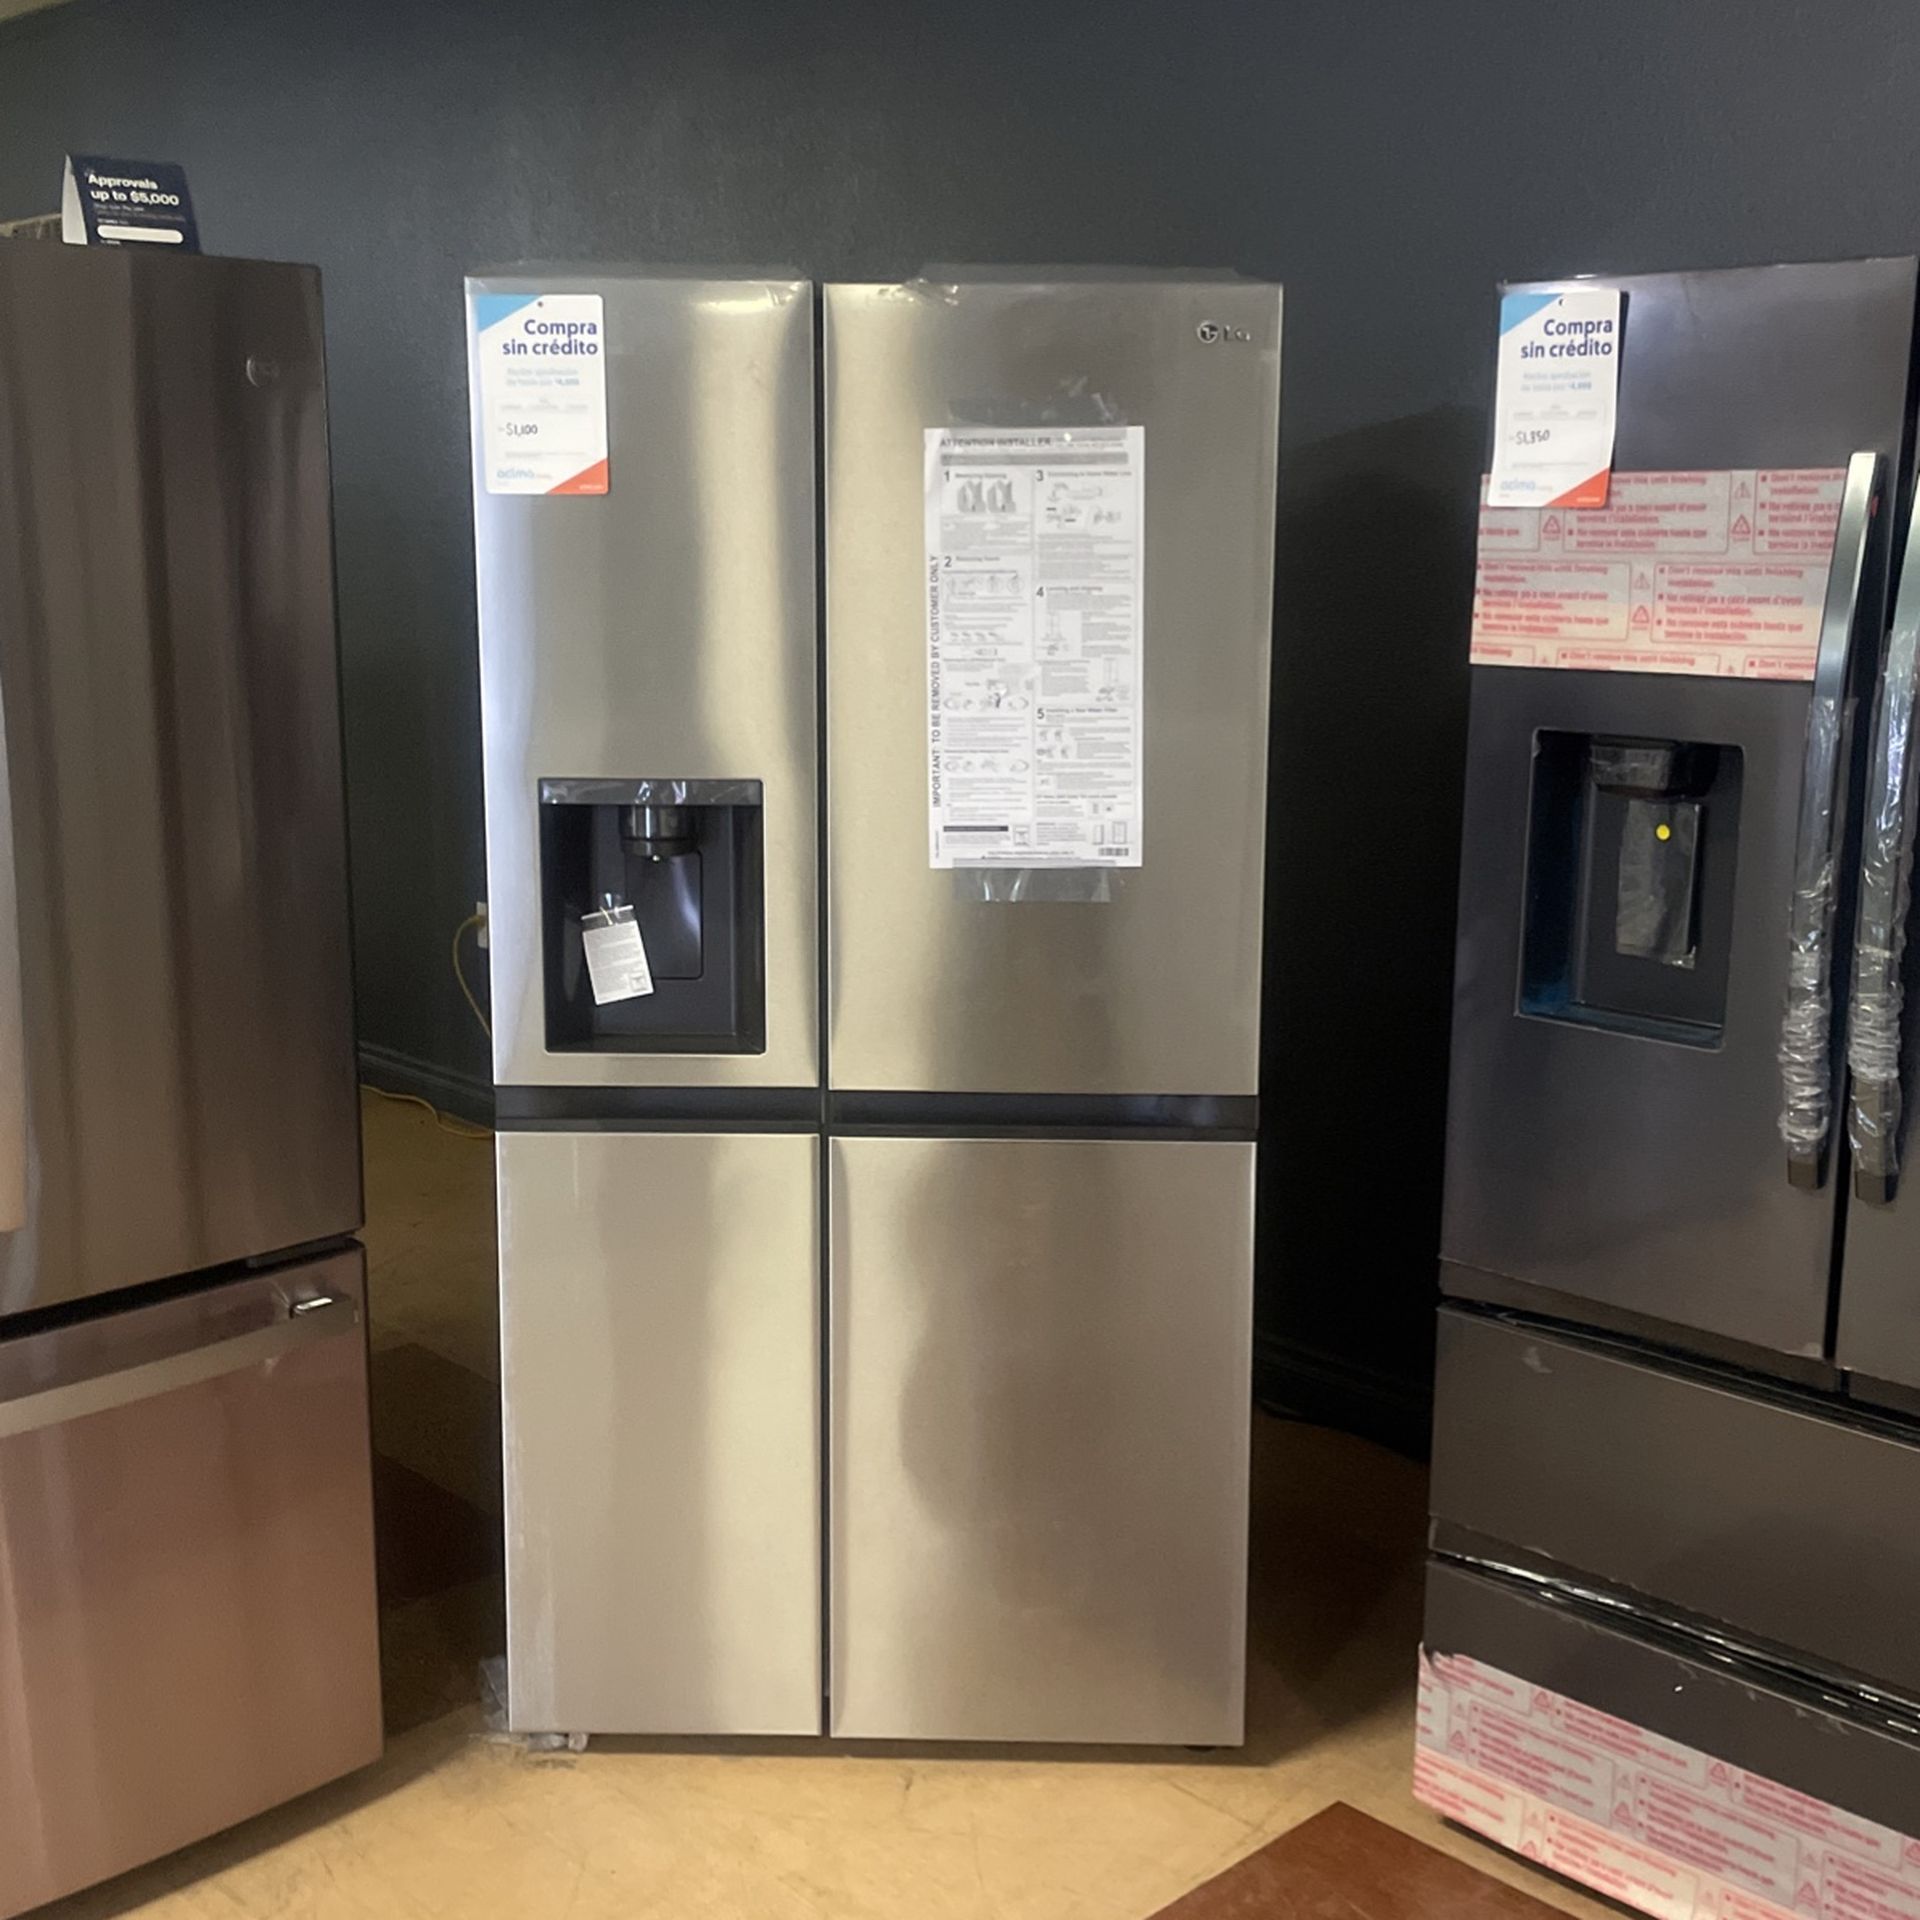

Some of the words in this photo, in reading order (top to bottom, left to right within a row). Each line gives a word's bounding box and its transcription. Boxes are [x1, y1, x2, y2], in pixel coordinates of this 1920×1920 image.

[88, 173, 158, 190] Approvals
[91, 190, 109, 203] up
[112, 190, 127, 202] to
[130, 190, 180, 207] $5,000
[523, 319, 598, 338] Compra
[1543, 318, 1614, 338] Compra
[502, 338, 528, 355] sin
[532, 338, 598, 355] crédito
[1520, 340, 1545, 358] sin
[1549, 336, 1613, 358] crédito
[930, 556, 939, 583] ONLY
[930, 585, 940, 643] CUSTOMER
[931, 644, 940, 659] BY
[931, 661, 941, 711] REMOVED
[931, 713, 941, 727] BE
[1037, 708, 1045, 720] 5
[931, 729, 941, 744] TO
